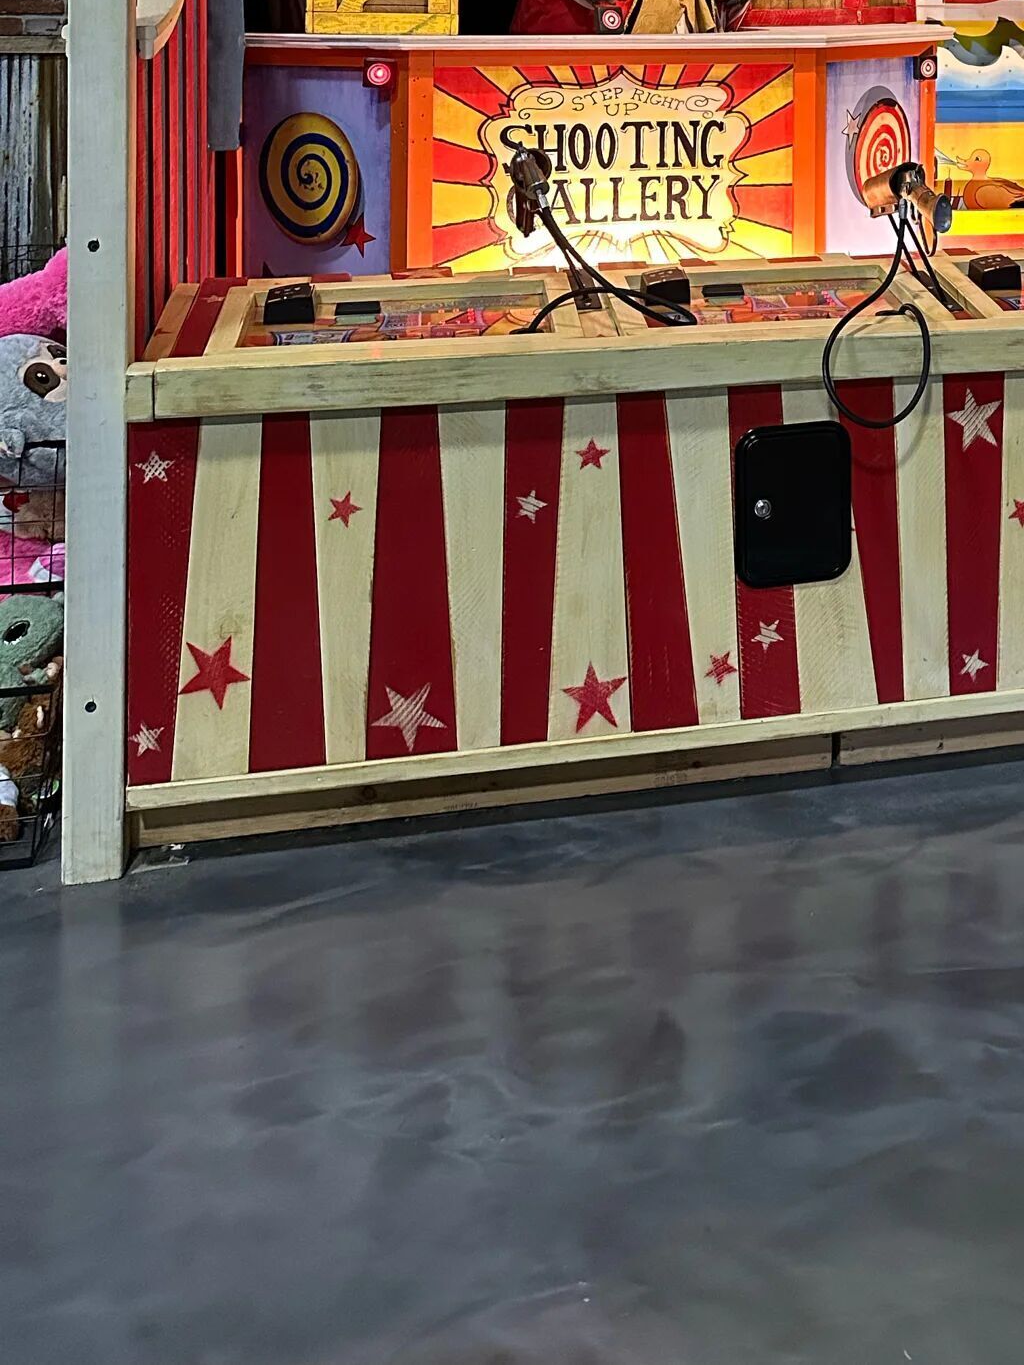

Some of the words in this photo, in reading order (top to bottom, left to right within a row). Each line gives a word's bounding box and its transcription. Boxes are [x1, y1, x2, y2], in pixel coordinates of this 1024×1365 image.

[571, 87, 624, 112] STEP
[631, 87, 685, 111] RIGHT
[603, 102, 640, 117] UP
